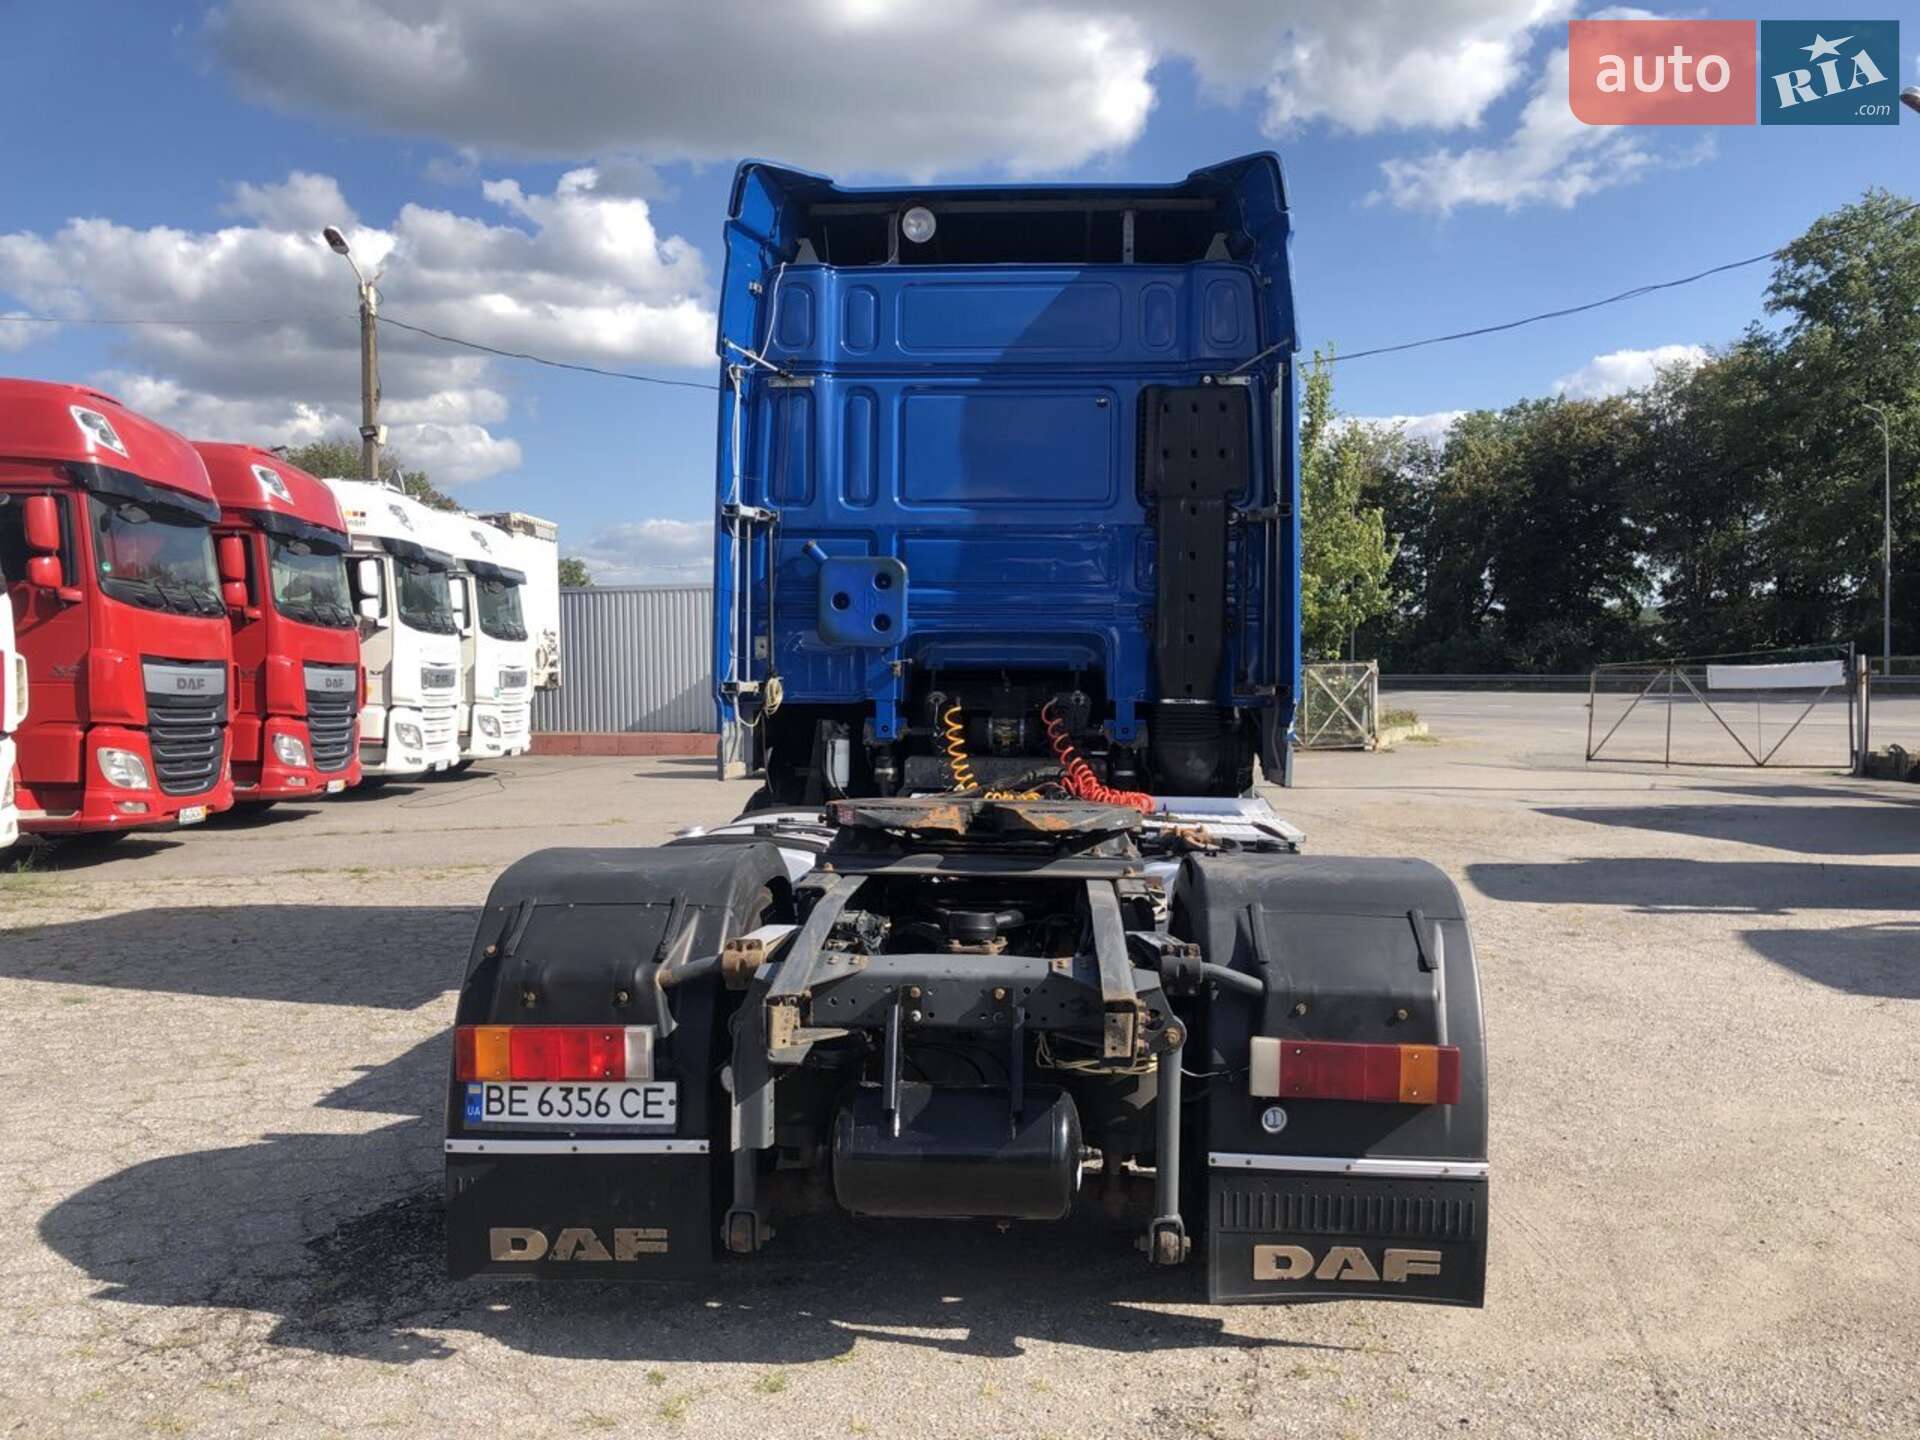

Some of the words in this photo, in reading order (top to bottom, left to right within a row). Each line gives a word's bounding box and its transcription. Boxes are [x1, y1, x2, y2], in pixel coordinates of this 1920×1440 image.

[177, 677, 205, 690] DAF
[467, 1105, 481, 1116] UA
[485, 1085, 528, 1116] BE
[538, 1087, 611, 1118] 6356
[620, 1088, 665, 1118] CE
[490, 1227, 668, 1261] DAF
[1253, 1244, 1442, 1282] DAF
